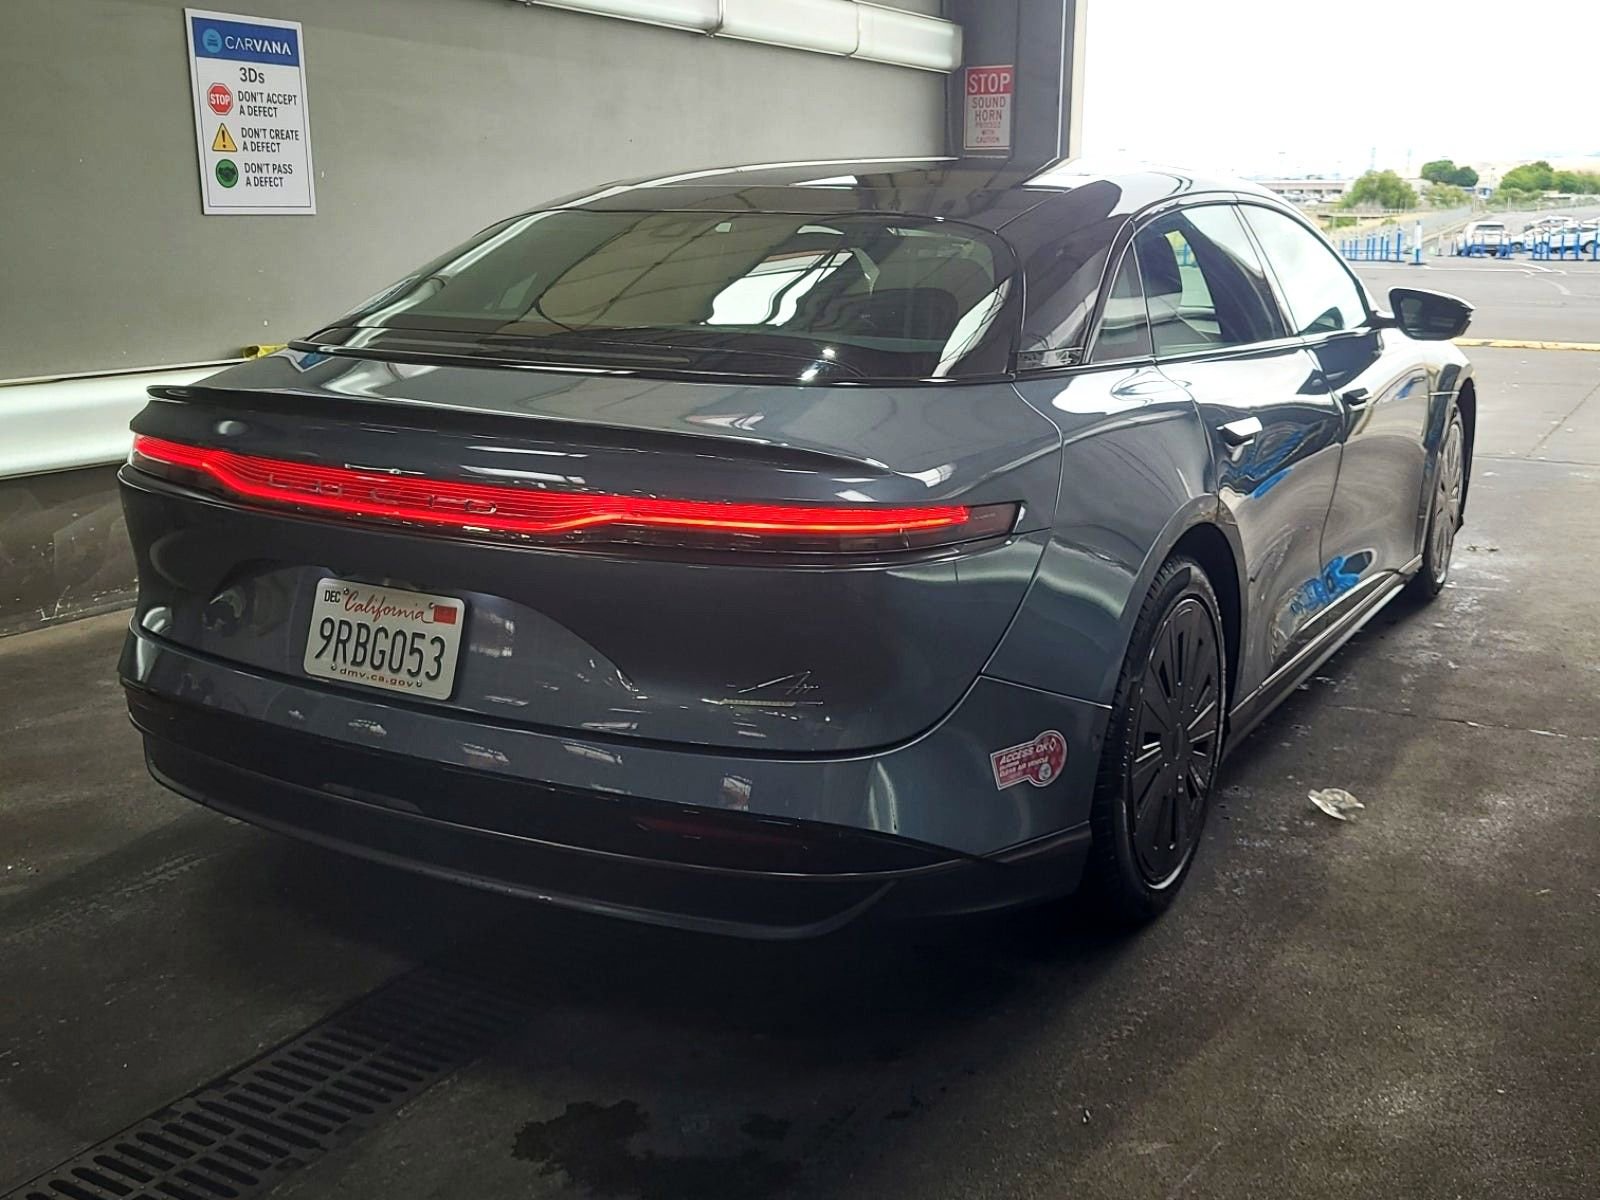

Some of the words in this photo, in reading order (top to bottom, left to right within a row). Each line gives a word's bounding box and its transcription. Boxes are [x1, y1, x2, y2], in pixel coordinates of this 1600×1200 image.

[225, 36, 292, 56] CARVANA
[239, 67, 265, 84] 3Ds
[969, 73, 1010, 93] STOP
[210, 93, 231, 106] STOP
[237, 90, 264, 103] DON'T
[266, 93, 298, 106] ACCEPT
[971, 97, 1006, 109] SOUND
[239, 105, 246, 116] A
[247, 106, 278, 118] DEFECT
[975, 110, 1002, 121] HORN
[241, 127, 267, 140] DON'T
[269, 129, 300, 141] CREATE
[242, 141, 249, 152] A
[250, 142, 281, 153] DEFECT
[244, 162, 270, 174] DON'T
[272, 163, 293, 175] PASS
[245, 176, 252, 187] A
[253, 177, 284, 187] DEFECT
[324, 589, 341, 603] DEC
[344, 591, 435, 624] California
[314, 617, 446, 681] 9RBG053
[339, 668, 415, 688] dmv.ca.gov
[1000, 746, 1035, 765] ACCESS
